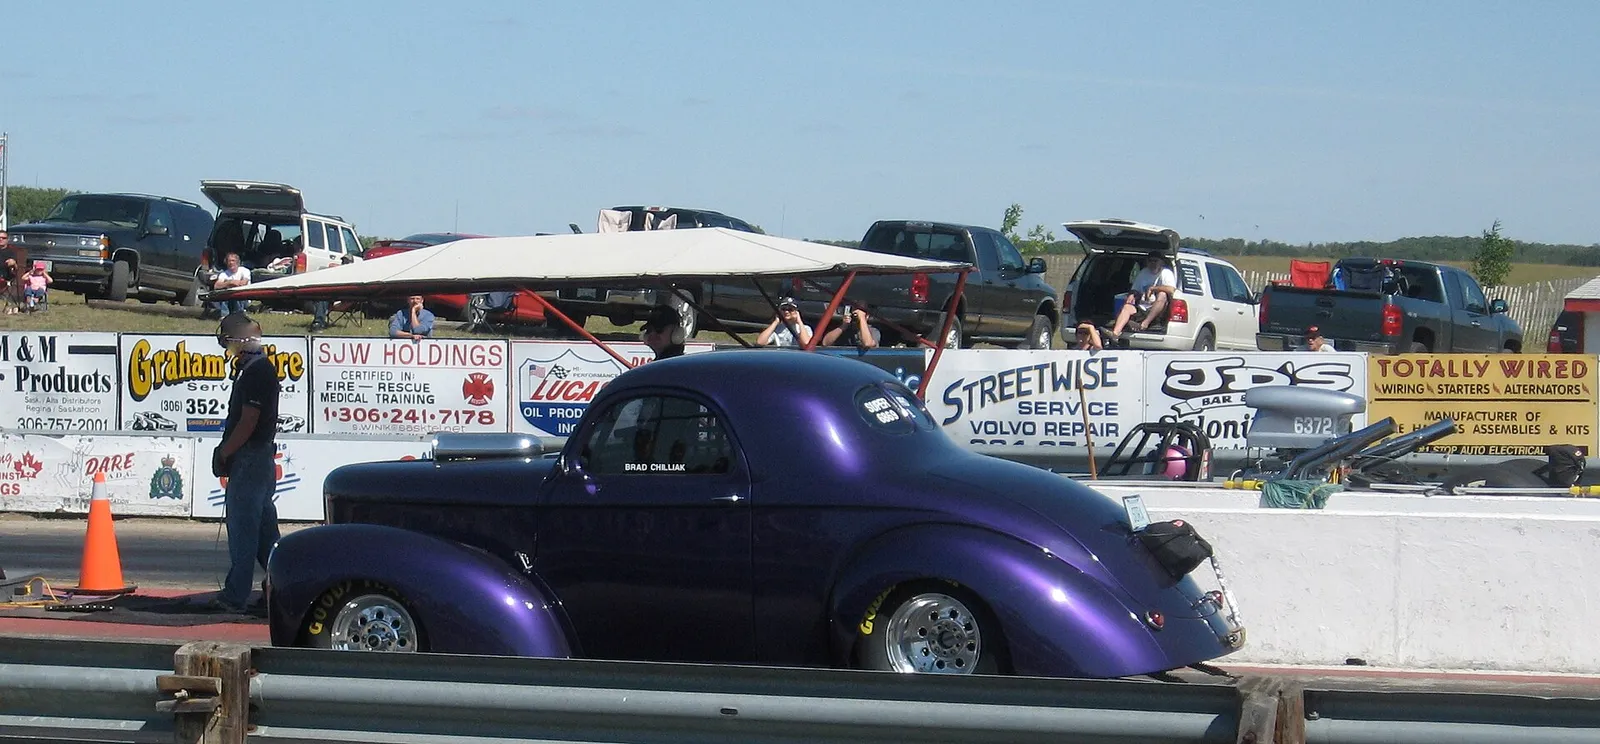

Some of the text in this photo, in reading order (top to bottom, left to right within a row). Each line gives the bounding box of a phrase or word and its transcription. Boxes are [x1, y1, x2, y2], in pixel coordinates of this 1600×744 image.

[16, 335, 35, 362] &
[38, 336, 57, 362] M
[318, 343, 503, 366] SJW HOLDINGS
[1377, 359, 1588, 379] TOTALLY WIRED
[14, 365, 111, 393] Products
[341, 371, 415, 381] CERTIFIED IN:
[326, 381, 355, 391] FIRE
[378, 383, 430, 393] RESCUE
[942, 356, 1119, 427] STREETWISE
[1381, 383, 1582, 395] WIRING STARTERS ALTERNATORS
[320, 393, 435, 405] MEDICAL TRAINING
[1201, 394, 1232, 406] BAR
[58, 405, 100, 413] Saskatoon
[160, 400, 183, 412] (306)
[523, 406, 543, 418] OIL
[1018, 400, 1119, 416] SERVCE
[1424, 410, 1541, 422] MANUFACTURER OF
[17, 417, 108, 430] 306-757-2001
[969, 420, 1120, 437] VOLVO REPAIR
[1294, 417, 1332, 434] 6372
[1472, 424, 1542, 435] ASSEMBLIES
[1549, 425, 1558, 435] &
[1565, 424, 1591, 435] KITS
[1433, 445, 1458, 455] STOP
[1460, 446, 1486, 455] AUTO
[1488, 446, 1546, 456] ELECTRICAL
[624, 463, 686, 471] BRAD CHILLIAK
